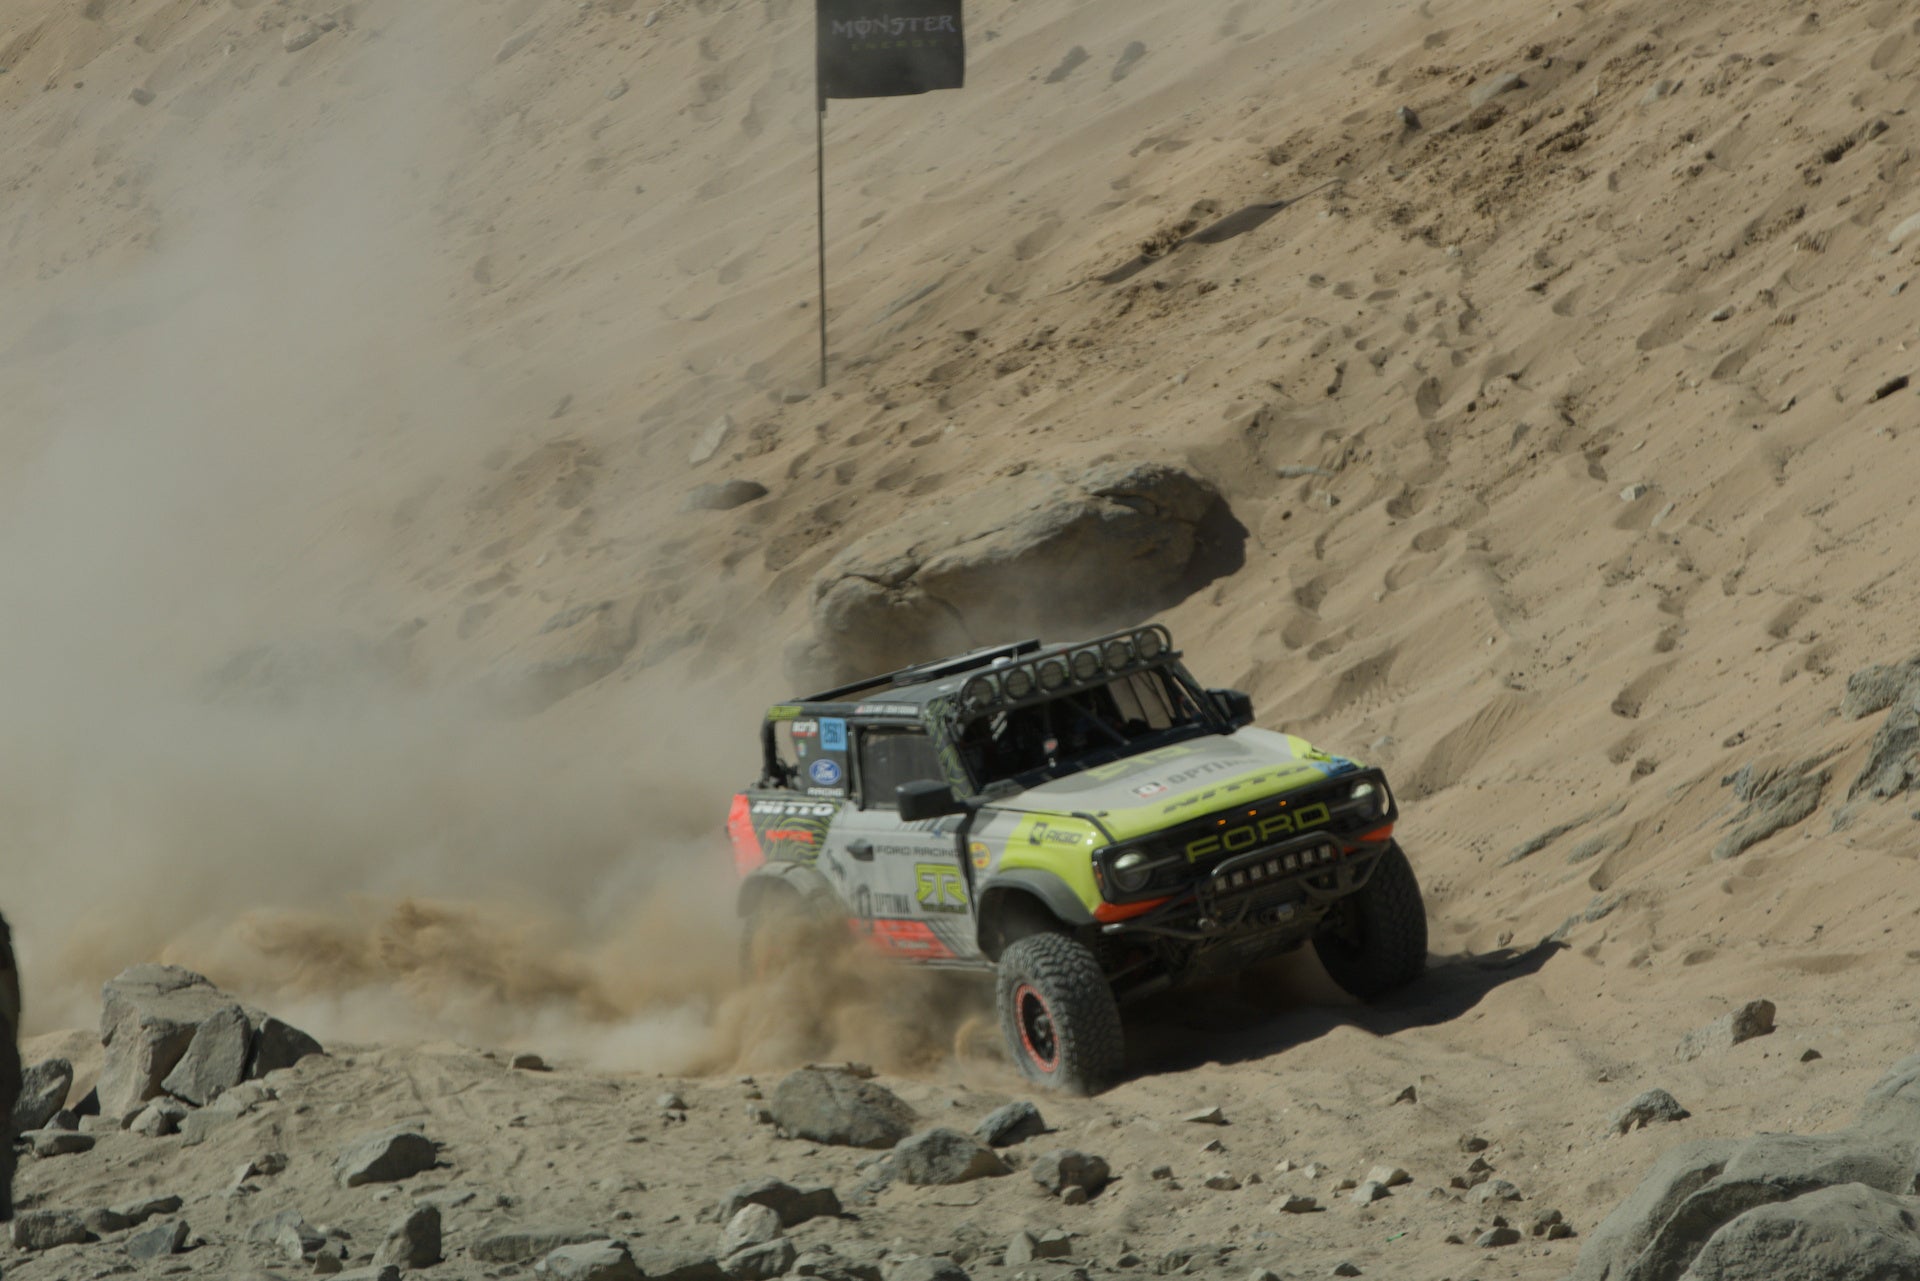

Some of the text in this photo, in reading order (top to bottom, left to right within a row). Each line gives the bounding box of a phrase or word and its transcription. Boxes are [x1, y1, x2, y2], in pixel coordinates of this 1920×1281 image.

[831, 14, 957, 39] MONSTER
[751, 801, 834, 816] NITTO
[1184, 802, 1331, 864] FORD
